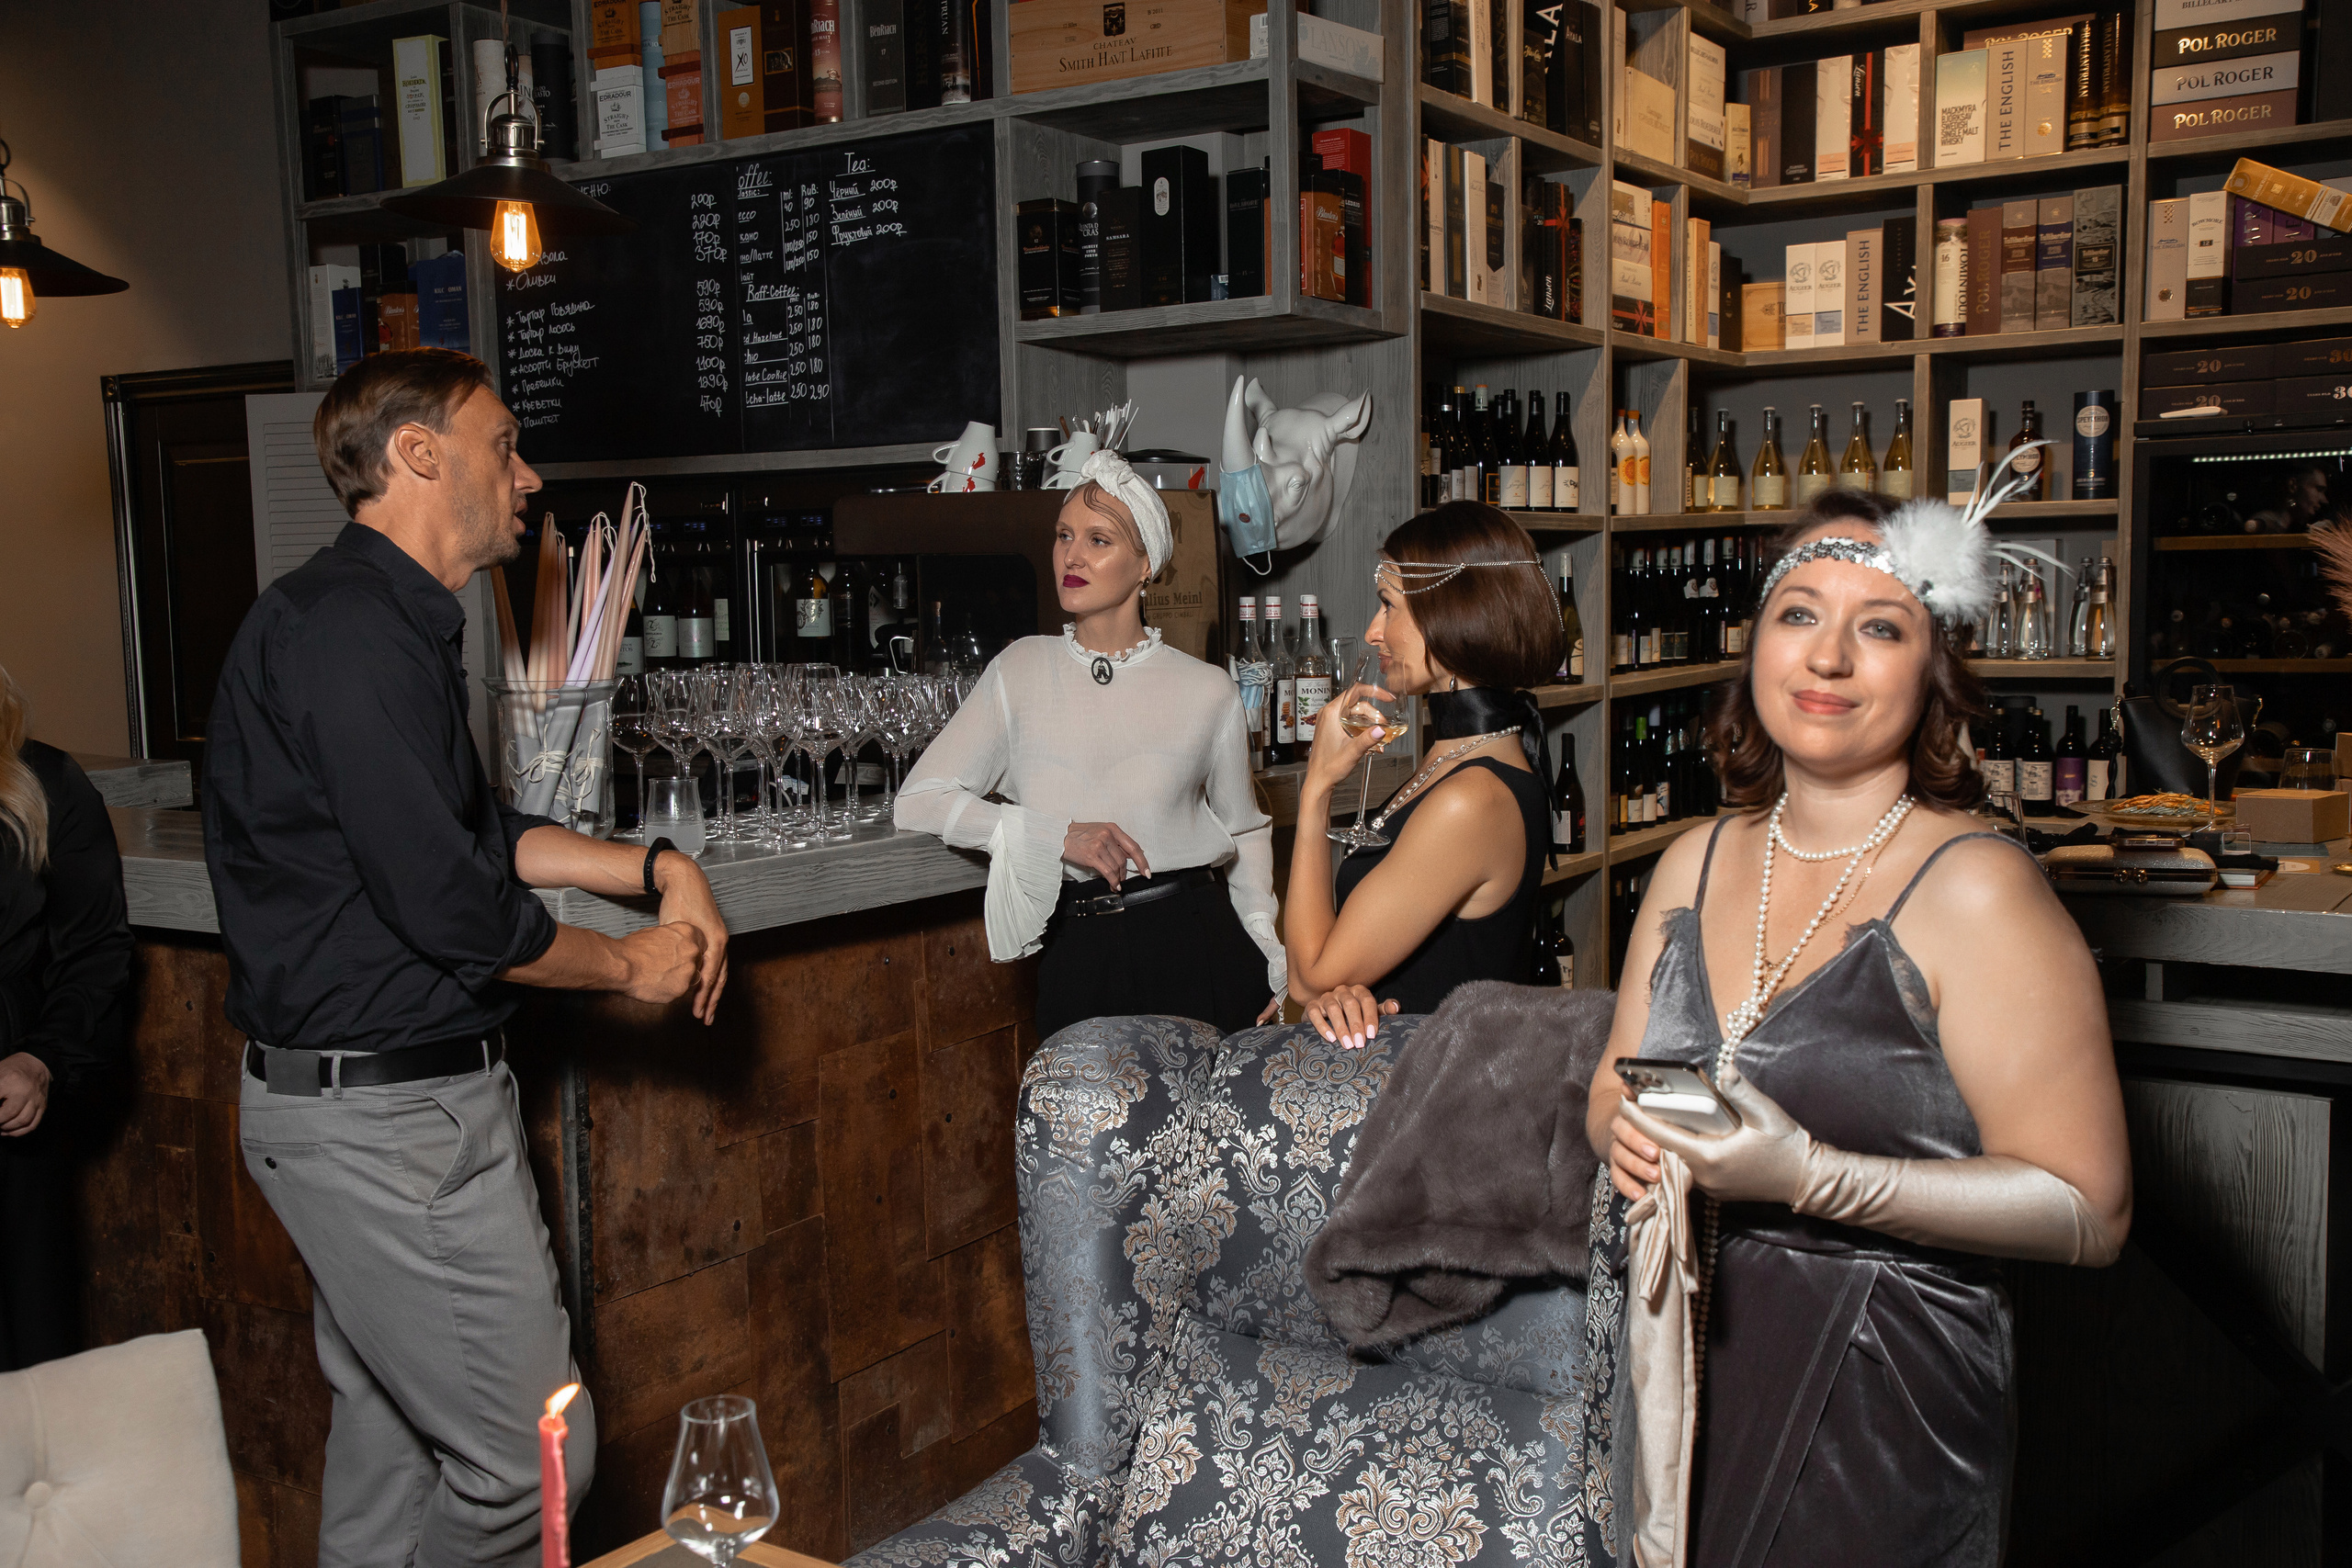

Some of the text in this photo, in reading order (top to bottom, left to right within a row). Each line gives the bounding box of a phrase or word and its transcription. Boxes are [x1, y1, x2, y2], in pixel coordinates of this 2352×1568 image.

[2177, 28, 2278, 54] POL ROGER
[1059, 57, 1094, 73] SMITH
[1130, 46, 1173, 62] LAFITTE
[667, 77, 701, 89] EDRADOUR
[2176, 66, 2274, 91] POL ROGER
[599, 91, 632, 102] EDRADOUR
[1998, 51, 2014, 152] THE ENGLISH
[1941, 104, 1976, 115] MACKMYRA
[2174, 105, 2272, 130] POL ROGER
[604, 113, 629, 123] STRAIGHT
[844, 152, 870, 174] Tea:
[736, 164, 772, 188] offee:
[785, 219, 800, 231] 250
[806, 213, 820, 228] 180
[1941, 254, 1951, 263] 16
[2290, 249, 2318, 265] 20
[1544, 275, 1555, 312] Lanson
[1856, 239, 1871, 335] THE ENGLISH
[2286, 286, 2312, 300] 20
[2197, 359, 2222, 373] 20
[809, 383, 830, 400] 290
[2196, 394, 2222, 408] 20
[1173, 592, 1204, 605] Meinl
[1302, 686, 1331, 695] MONIN
